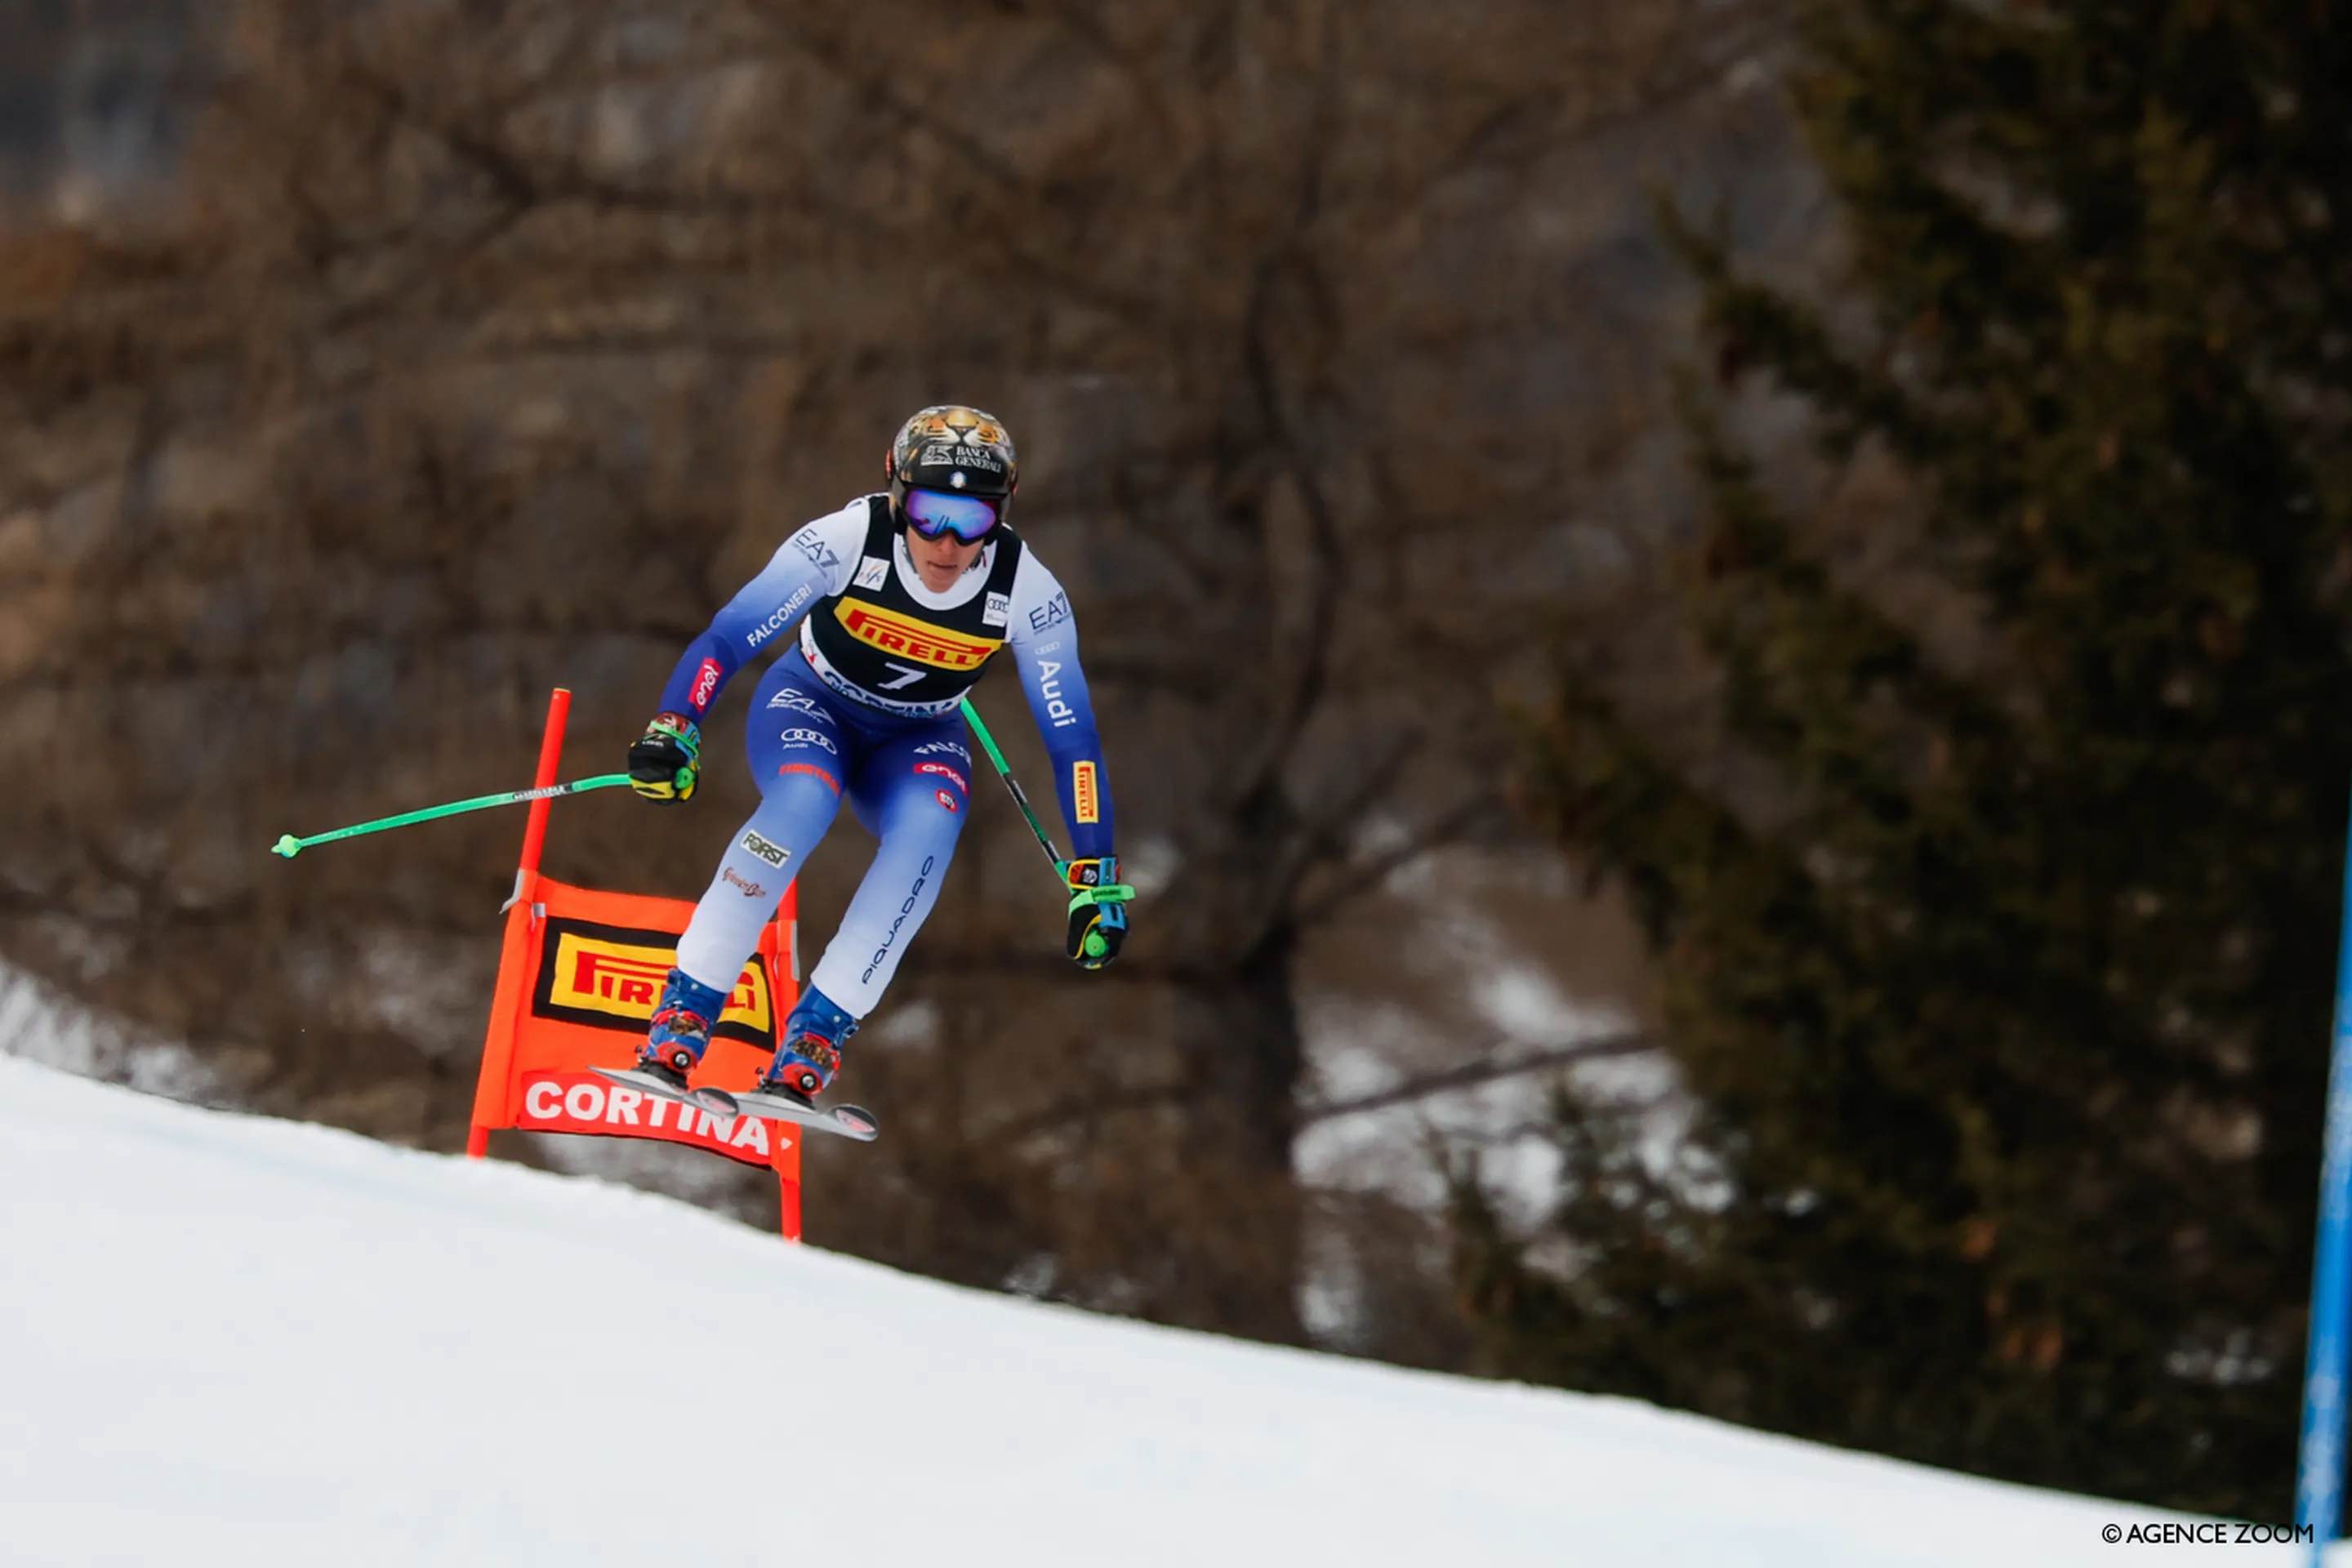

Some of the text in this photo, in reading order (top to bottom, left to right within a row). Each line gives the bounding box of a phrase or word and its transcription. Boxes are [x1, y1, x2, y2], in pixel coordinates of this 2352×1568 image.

[955, 455, 1002, 473] GENERALI
[956, 446, 991, 460] BANCA
[795, 528, 840, 568] EA7
[746, 582, 813, 648] FALCONERI
[1028, 591, 1067, 630] EA7
[696, 664, 719, 706] enel
[877, 662, 928, 690] 7
[1037, 660, 1076, 728] Audi
[771, 688, 836, 727] EA7
[1078, 766, 1094, 817] PIRELLI
[742, 832, 788, 866] FORST
[862, 854, 935, 985] PIQUADRO
[525, 1080, 770, 1156] CORTINA
